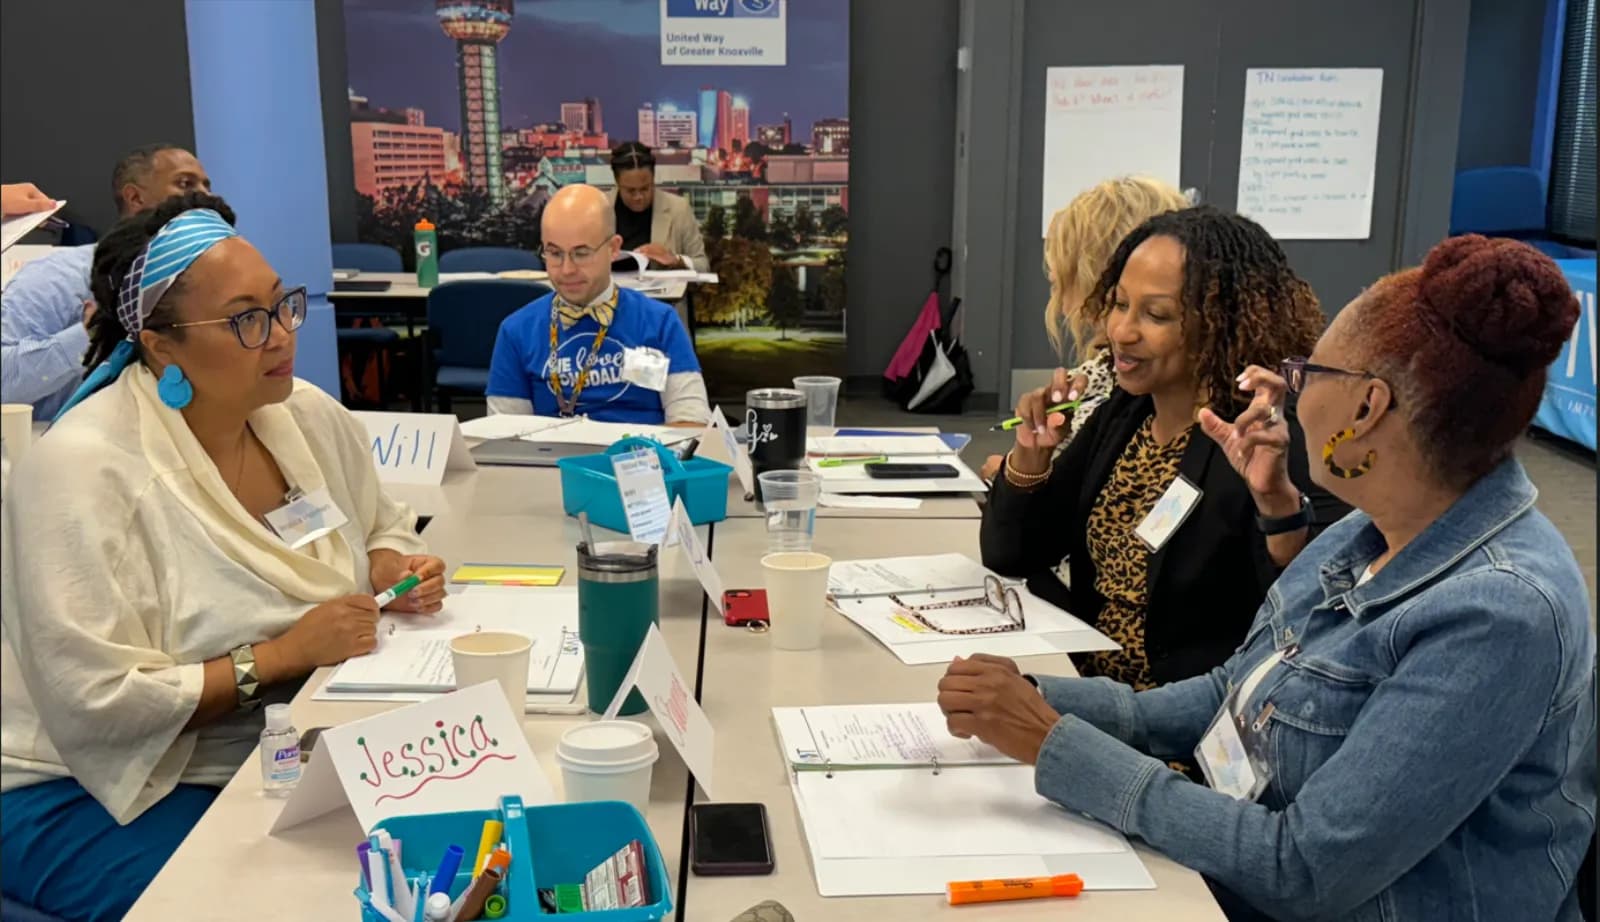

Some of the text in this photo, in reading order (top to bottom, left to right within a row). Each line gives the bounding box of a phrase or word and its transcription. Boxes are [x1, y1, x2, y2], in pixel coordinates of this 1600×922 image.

[693, 0, 729, 15] Way
[666, 33, 725, 45] United Way
[666, 46, 764, 57] of Greater Knoxville
[417, 241, 431, 257] G
[371, 423, 436, 470] Will
[357, 714, 499, 787] Jessica
